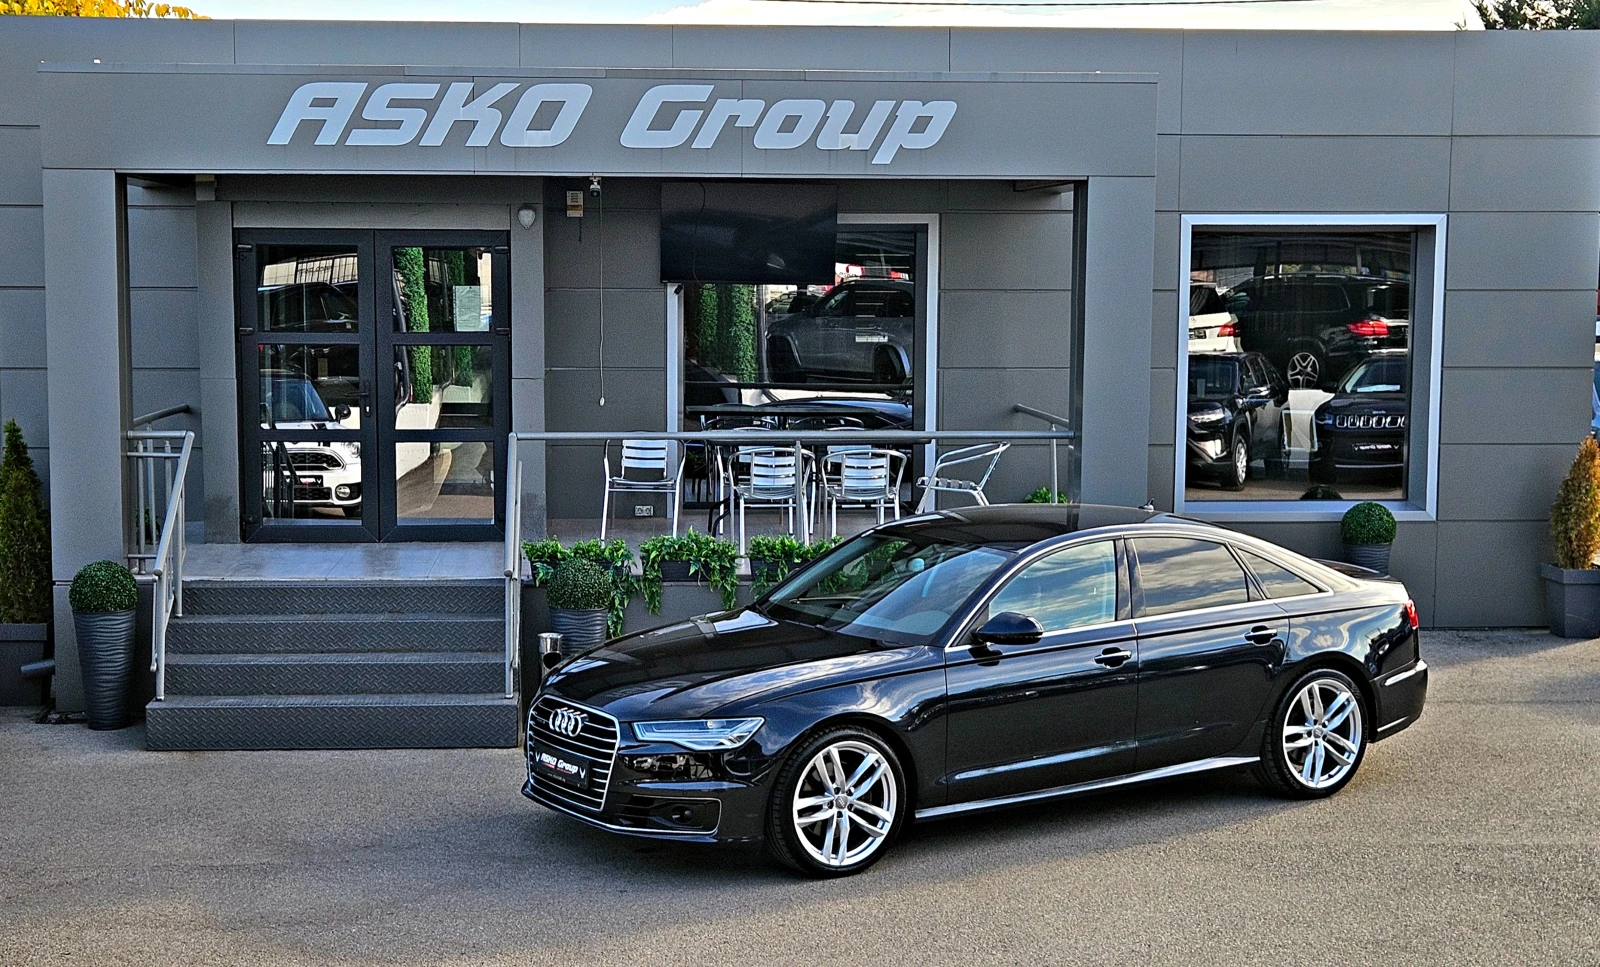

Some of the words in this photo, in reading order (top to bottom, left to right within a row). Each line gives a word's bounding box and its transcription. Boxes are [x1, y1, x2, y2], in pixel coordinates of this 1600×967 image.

[267, 82, 592, 147] ASKO
[620, 84, 958, 164] Group
[540, 752, 557, 766] ASKO
[557, 759, 578, 774] Group
